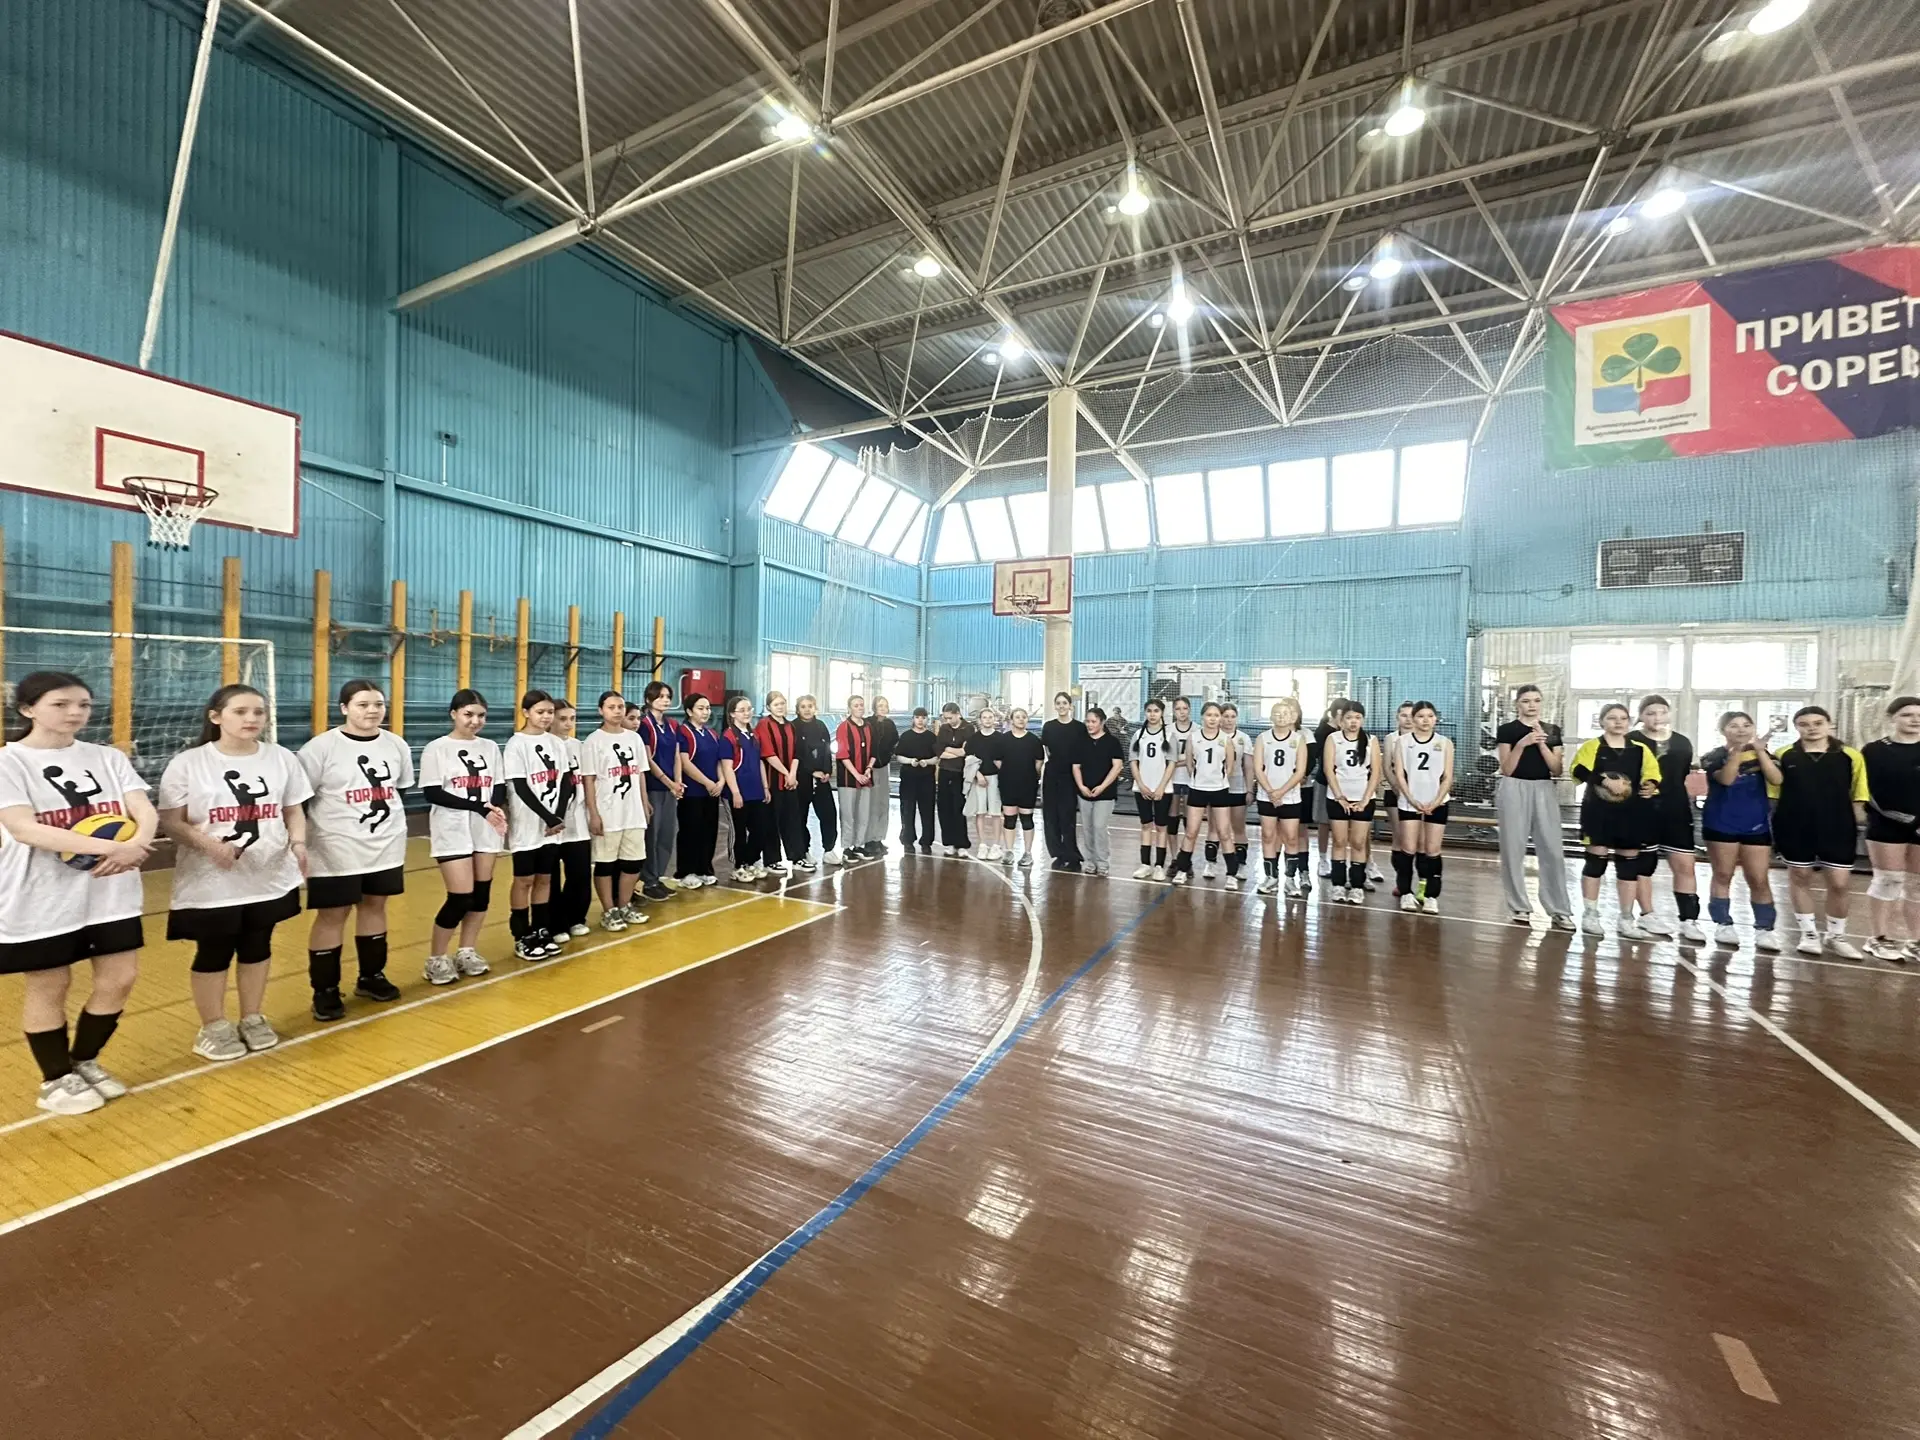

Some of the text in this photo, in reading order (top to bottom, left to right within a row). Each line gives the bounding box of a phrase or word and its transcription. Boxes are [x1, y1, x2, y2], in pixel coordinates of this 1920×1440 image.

[1146, 742, 1156, 758] 6
[1205, 747, 1213, 764] 1
[1273, 749, 1286, 767] 8
[1346, 749, 1358, 767] 3
[1417, 752, 1430, 771] 2
